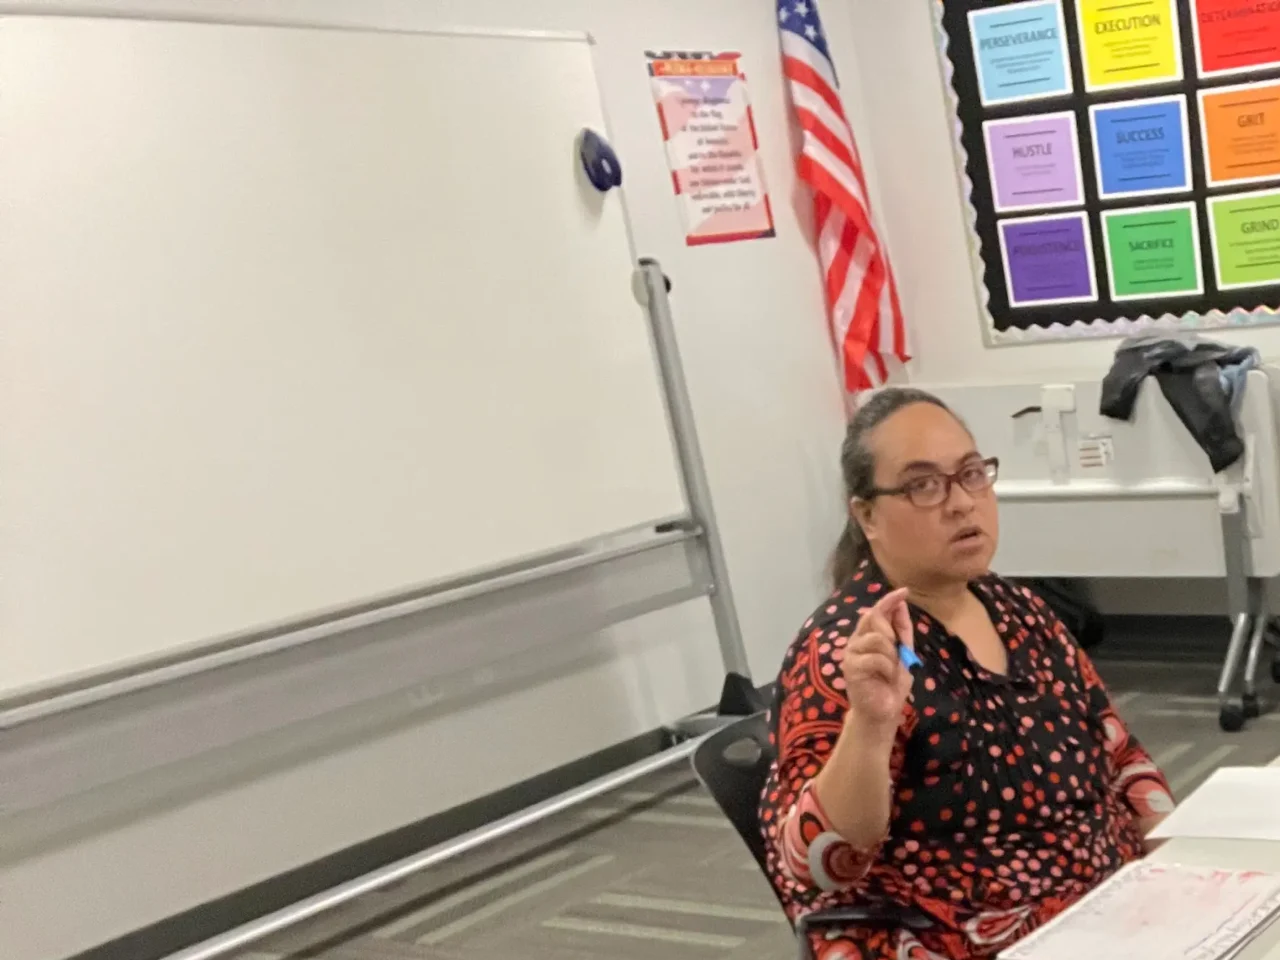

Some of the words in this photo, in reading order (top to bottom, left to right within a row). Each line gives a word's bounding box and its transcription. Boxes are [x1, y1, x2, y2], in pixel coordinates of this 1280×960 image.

[1095, 14, 1161, 34] EXECUTION
[980, 27, 1058, 50] PERSEVERANCE
[1237, 112, 1265, 128] GRIT
[1116, 127, 1165, 144] SUCCESS
[1012, 142, 1053, 158] HUSTLE
[1240, 218, 1280, 234] GRIND
[1128, 238, 1174, 252] SACRIFICE
